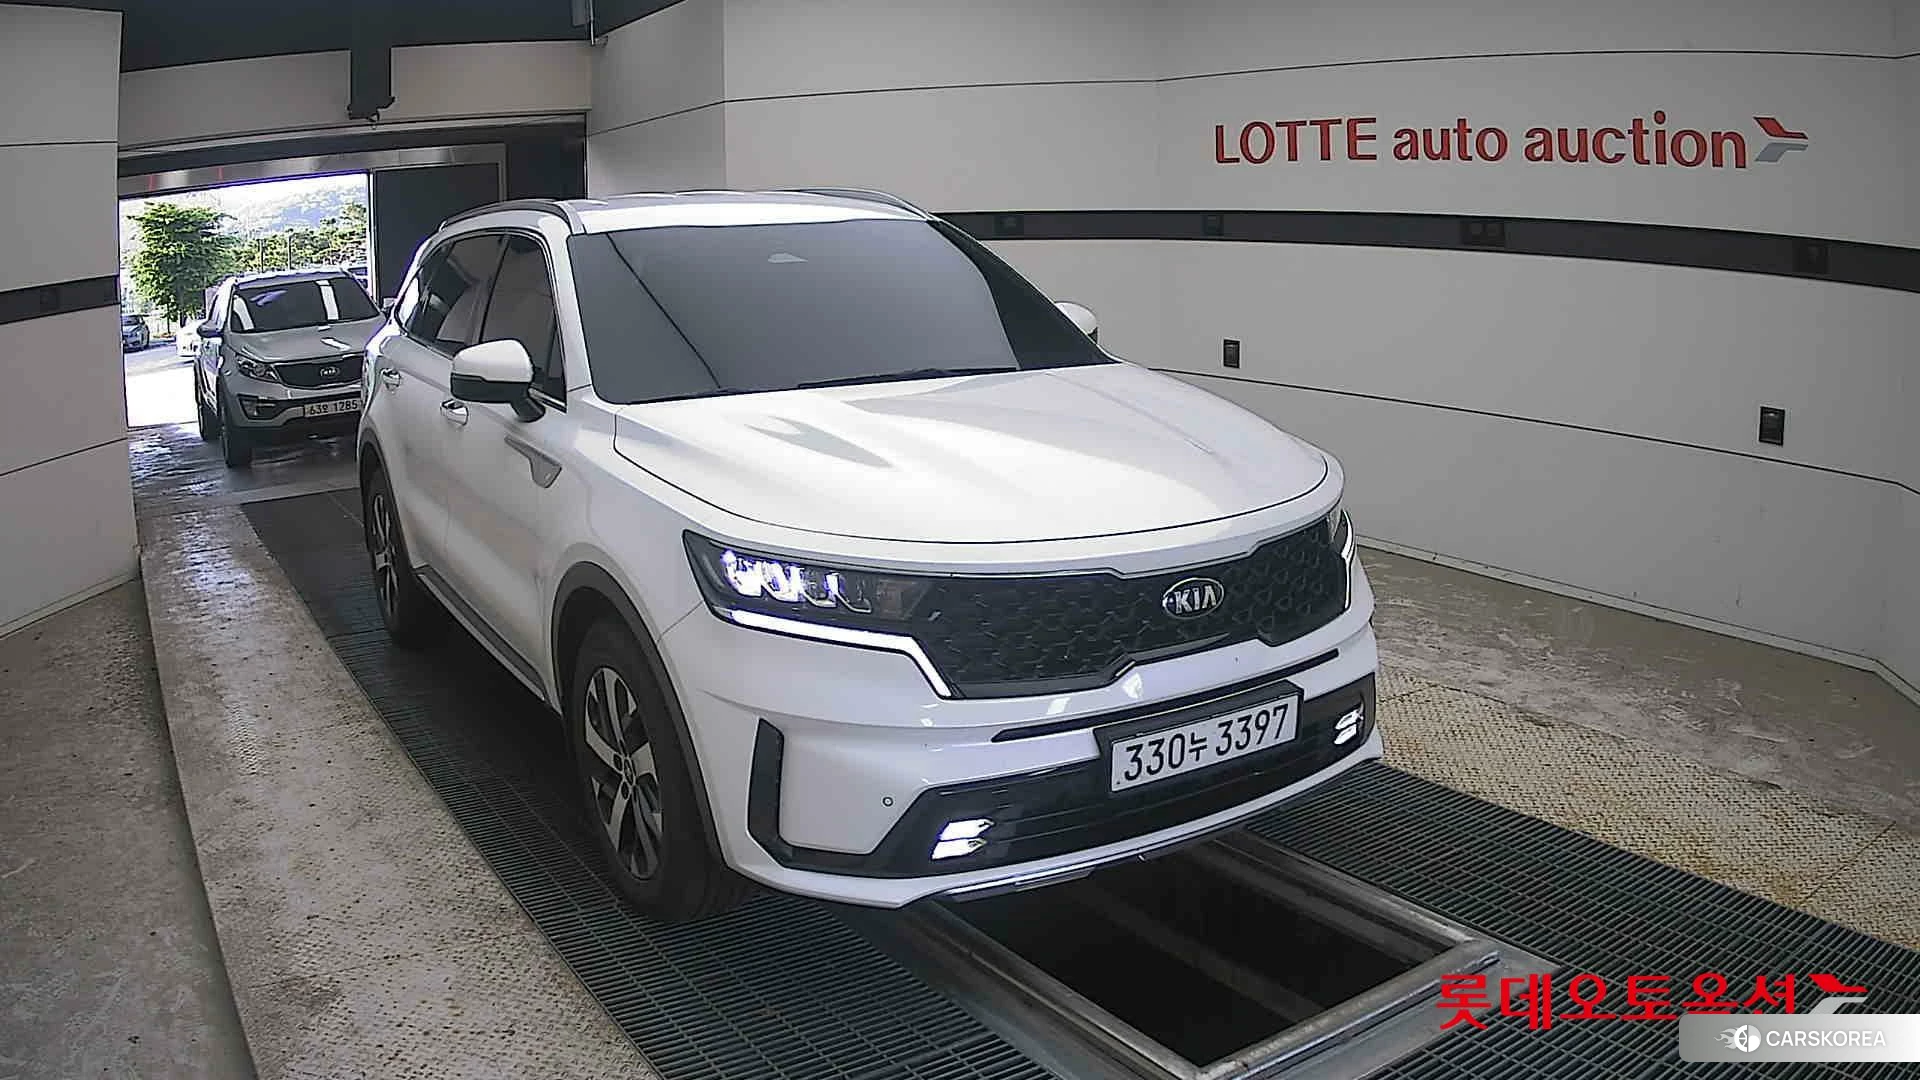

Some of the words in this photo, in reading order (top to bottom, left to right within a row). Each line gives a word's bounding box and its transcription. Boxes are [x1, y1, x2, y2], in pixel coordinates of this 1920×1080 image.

[1214, 116, 1378, 164] LOTTE
[1392, 117, 1509, 162] auto
[1523, 110, 1748, 170] auction
[335, 399, 358, 412] 1285
[1173, 584, 1218, 615] KIA
[1124, 731, 1208, 781] 330누
[1214, 704, 1289, 757] 3397
